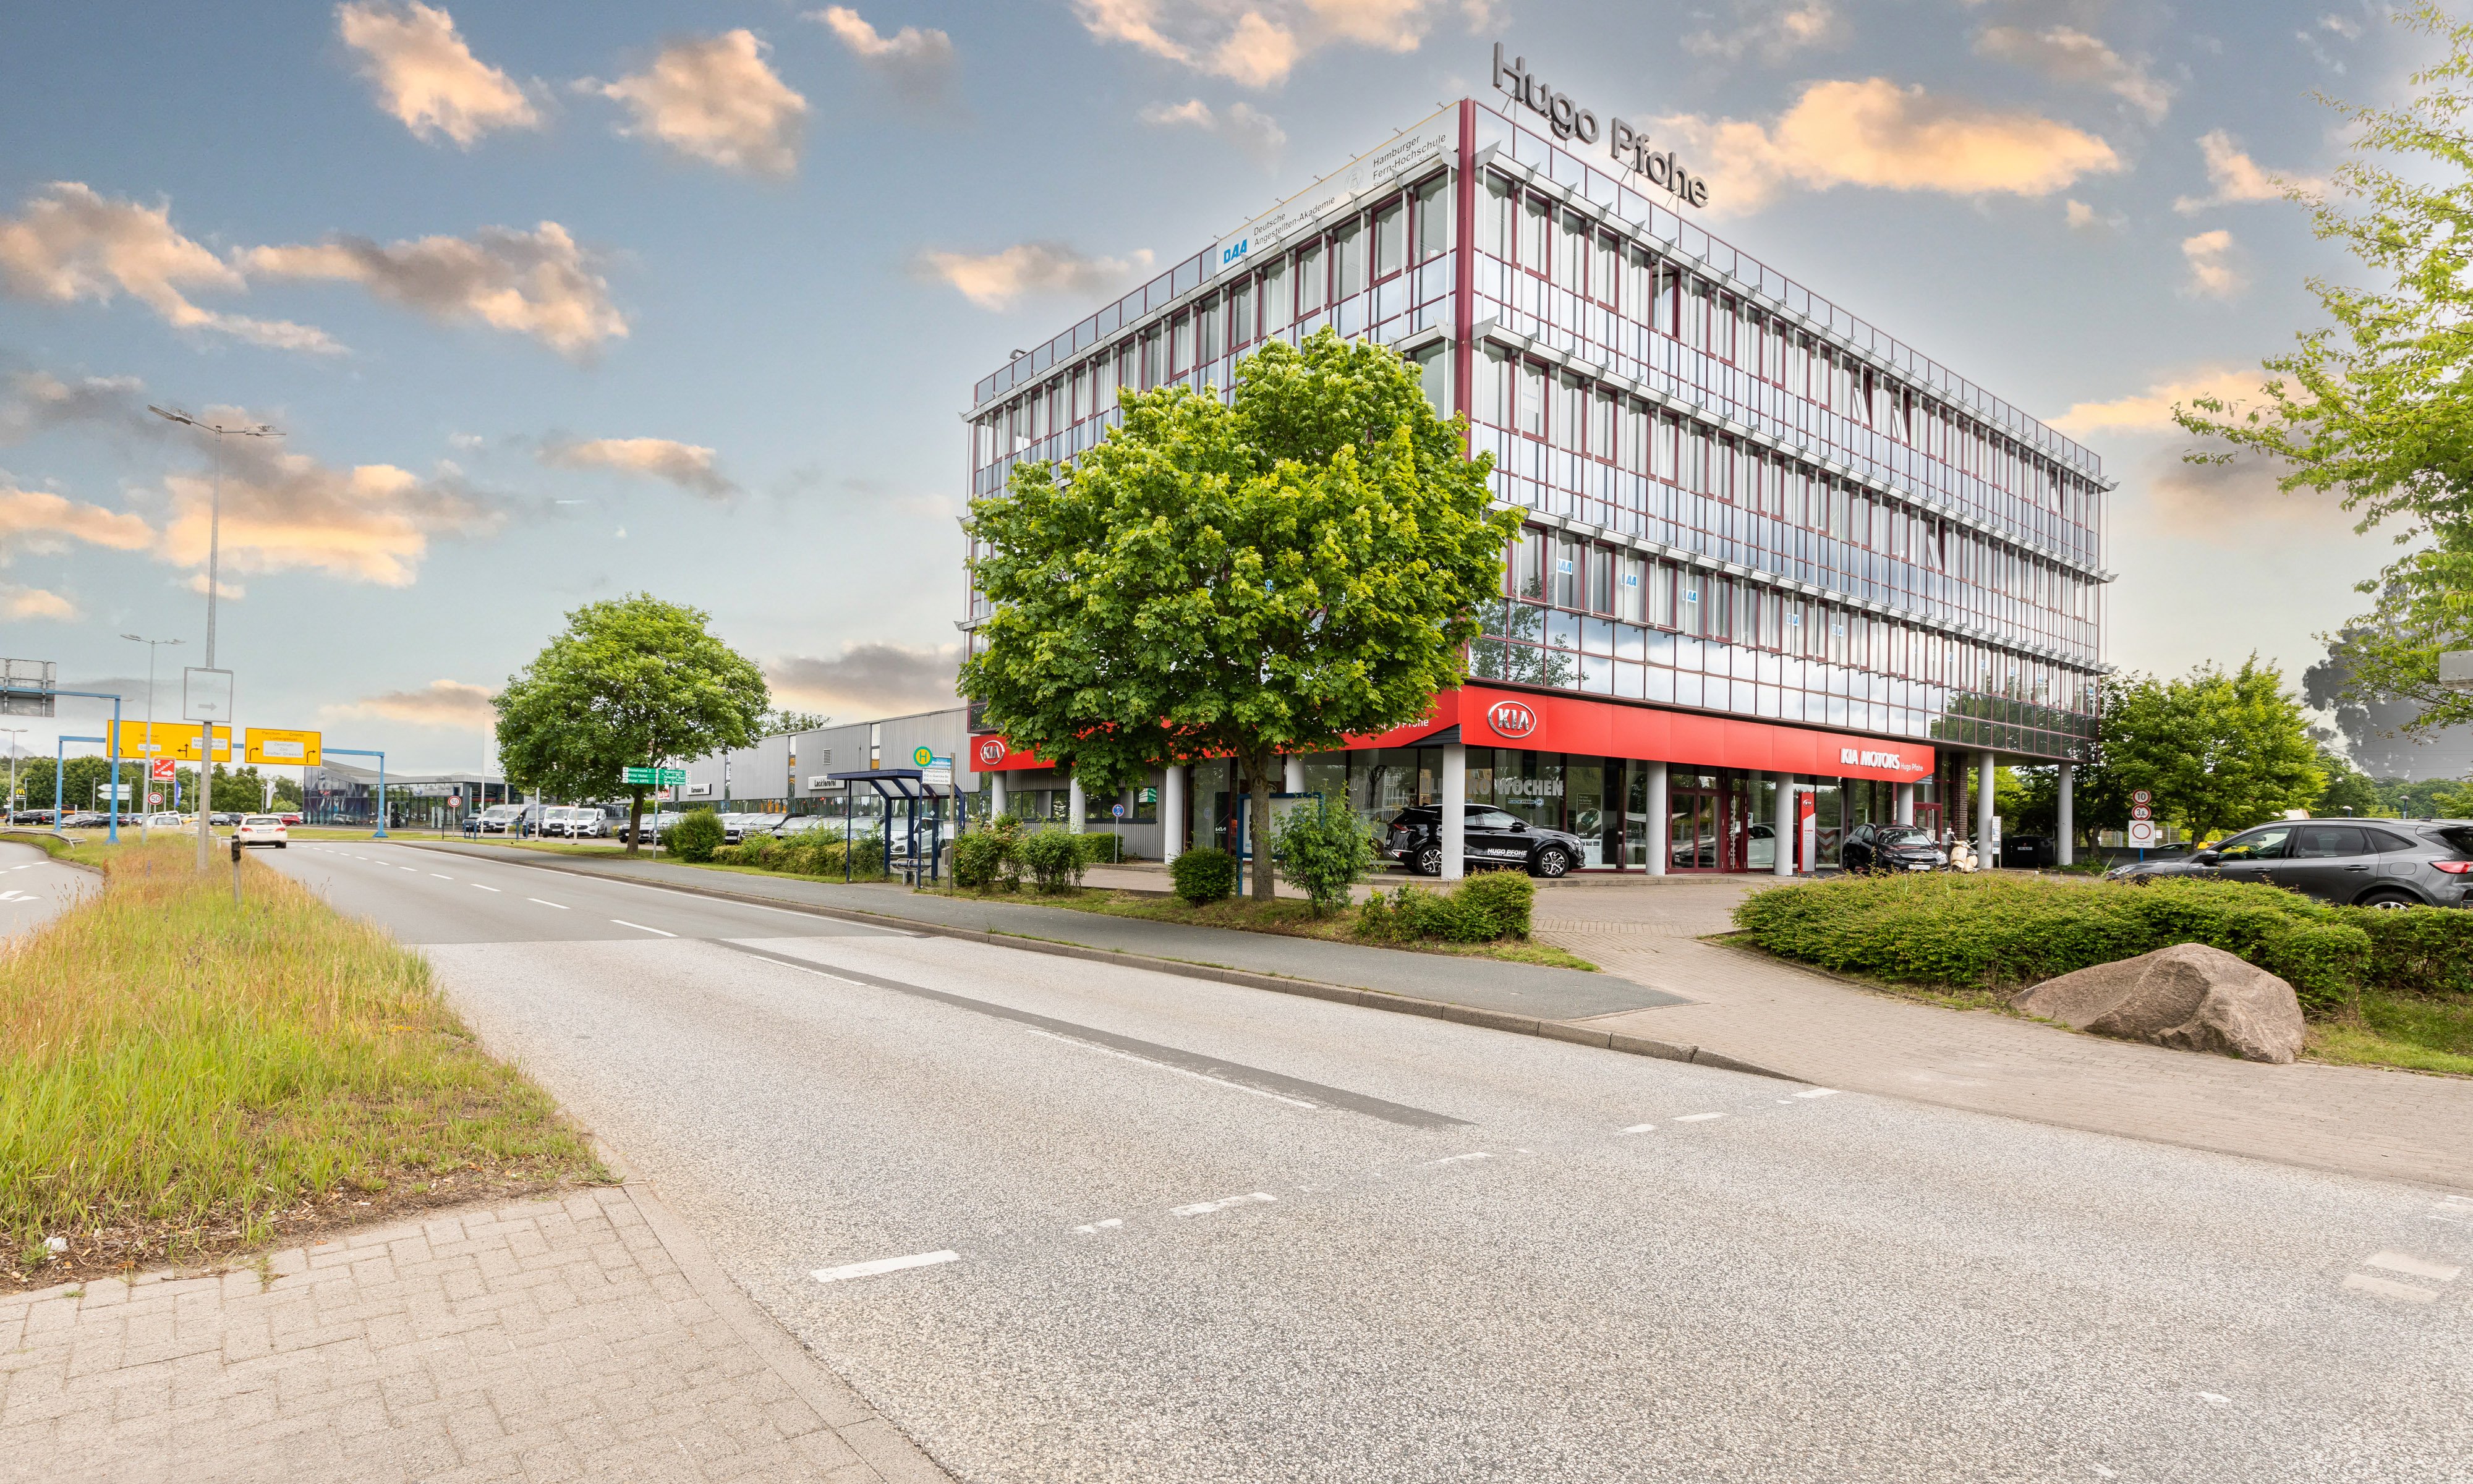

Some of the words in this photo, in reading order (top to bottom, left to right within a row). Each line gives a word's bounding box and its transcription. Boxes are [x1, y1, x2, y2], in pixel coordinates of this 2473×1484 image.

[1492, 41, 1599, 145] Hugo
[1610, 117, 1709, 208] Pfohe
[1373, 135, 1421, 168] Hamburger
[1373, 134, 1446, 180] Fern-Hochschule
[1254, 197, 1335, 248] Angestellten-Akademie
[1254, 213, 1286, 236] Deutsche
[1224, 238, 1247, 265] DAA
[1497, 708, 1529, 731] KIA
[919, 751, 927, 762] H
[984, 746, 1000, 759] KIA
[1840, 748, 1859, 765] KIA
[1860, 750, 1900, 770] MOTORS
[155, 760, 173, 774] BAUHAUS
[1901, 763, 1911, 771] Hugo
[1912, 763, 1923, 771] Pfohe
[1497, 779, 1563, 796] WOCHEN
